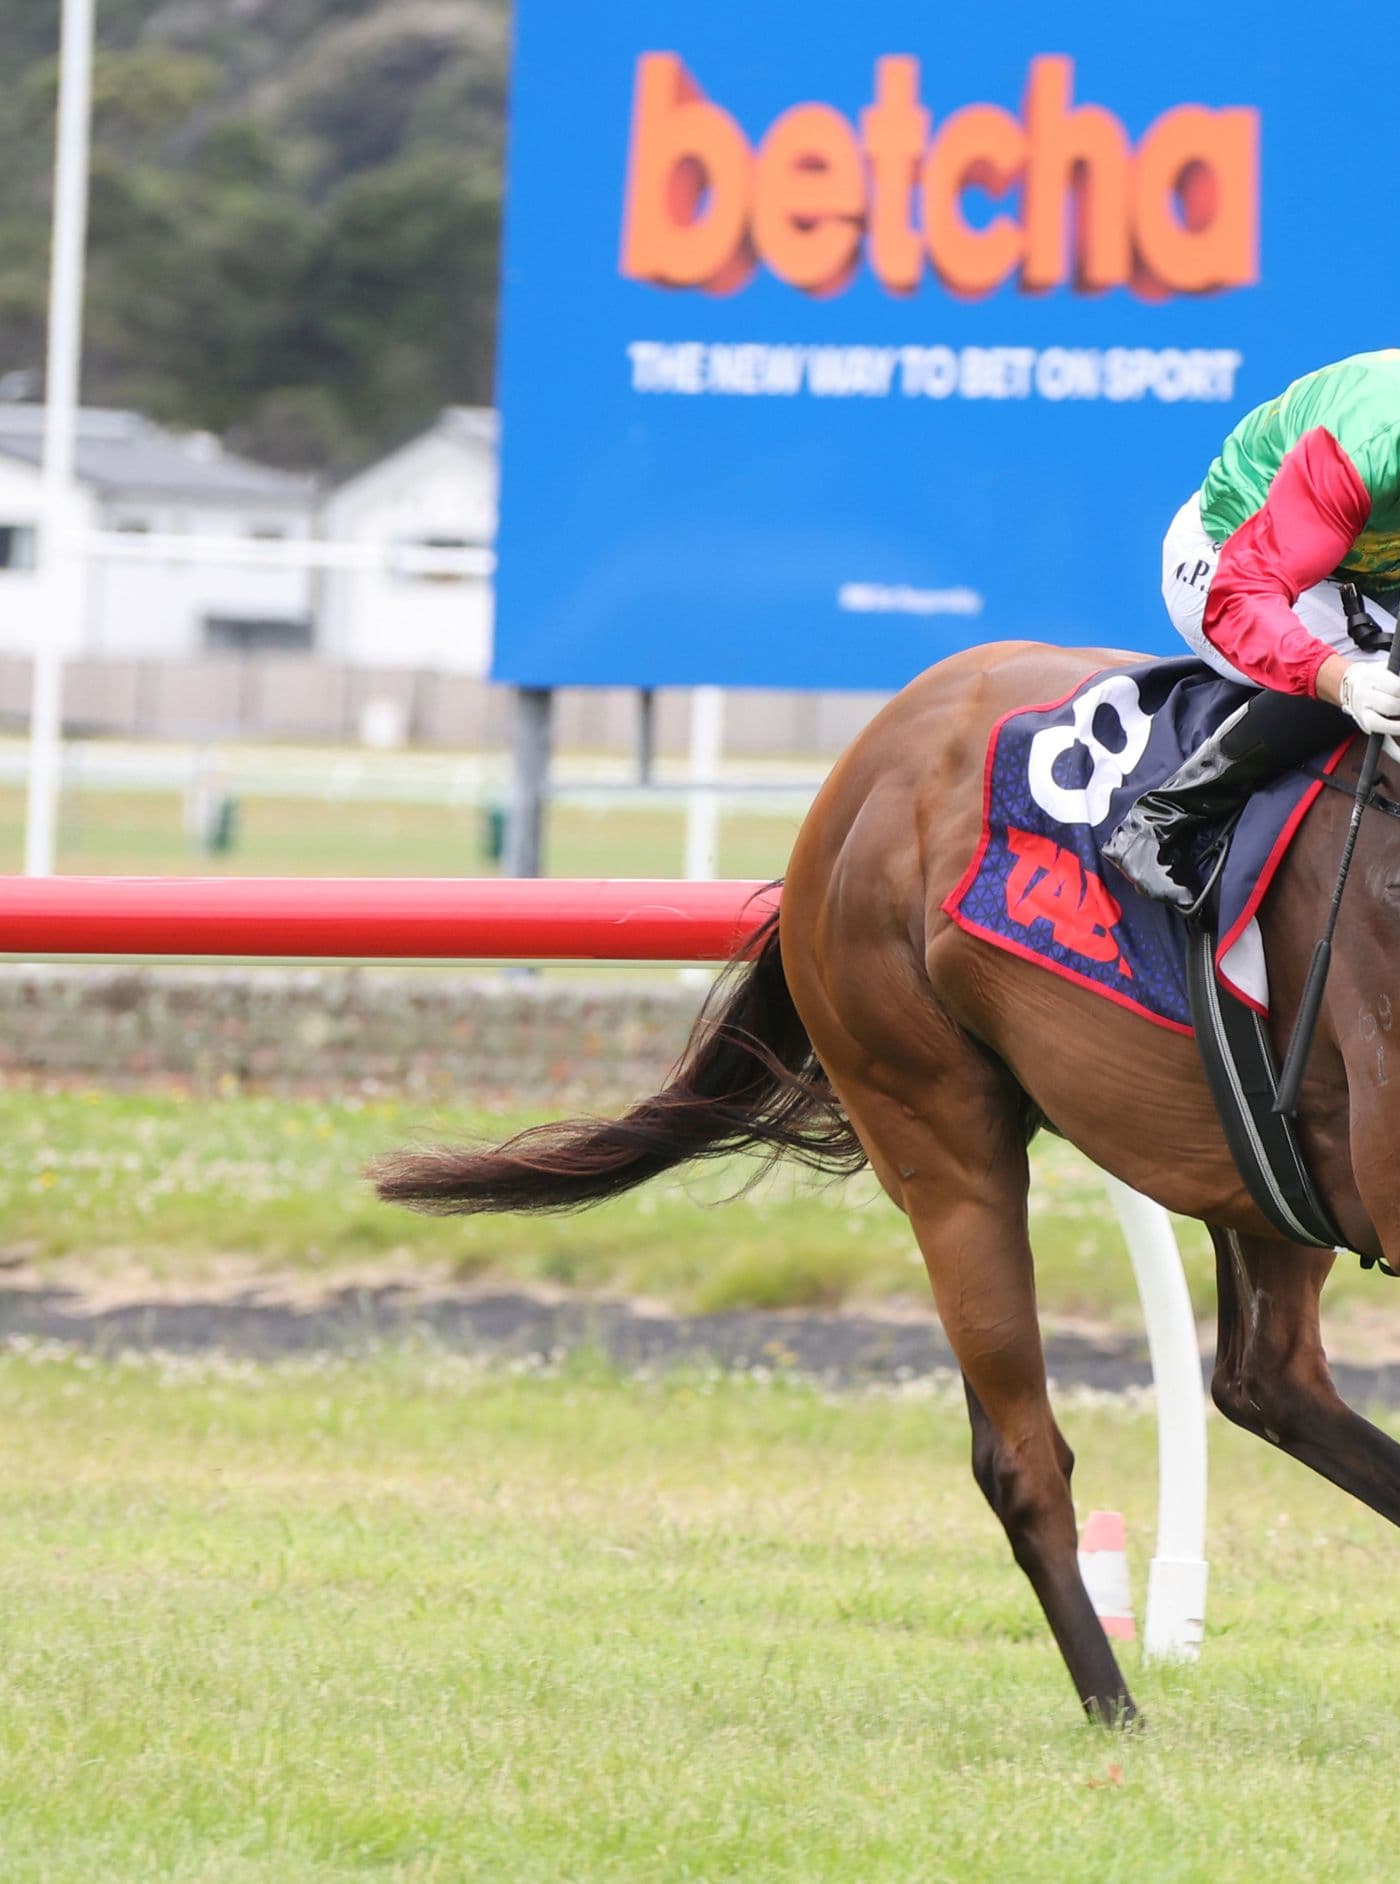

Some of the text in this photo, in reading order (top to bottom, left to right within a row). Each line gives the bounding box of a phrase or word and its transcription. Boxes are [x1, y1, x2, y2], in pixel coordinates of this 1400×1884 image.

[618, 51, 1261, 303] betcha
[629, 341, 1242, 403] THE NEW WAY TO BET ON SPORT
[1028, 675, 1154, 827] 8
